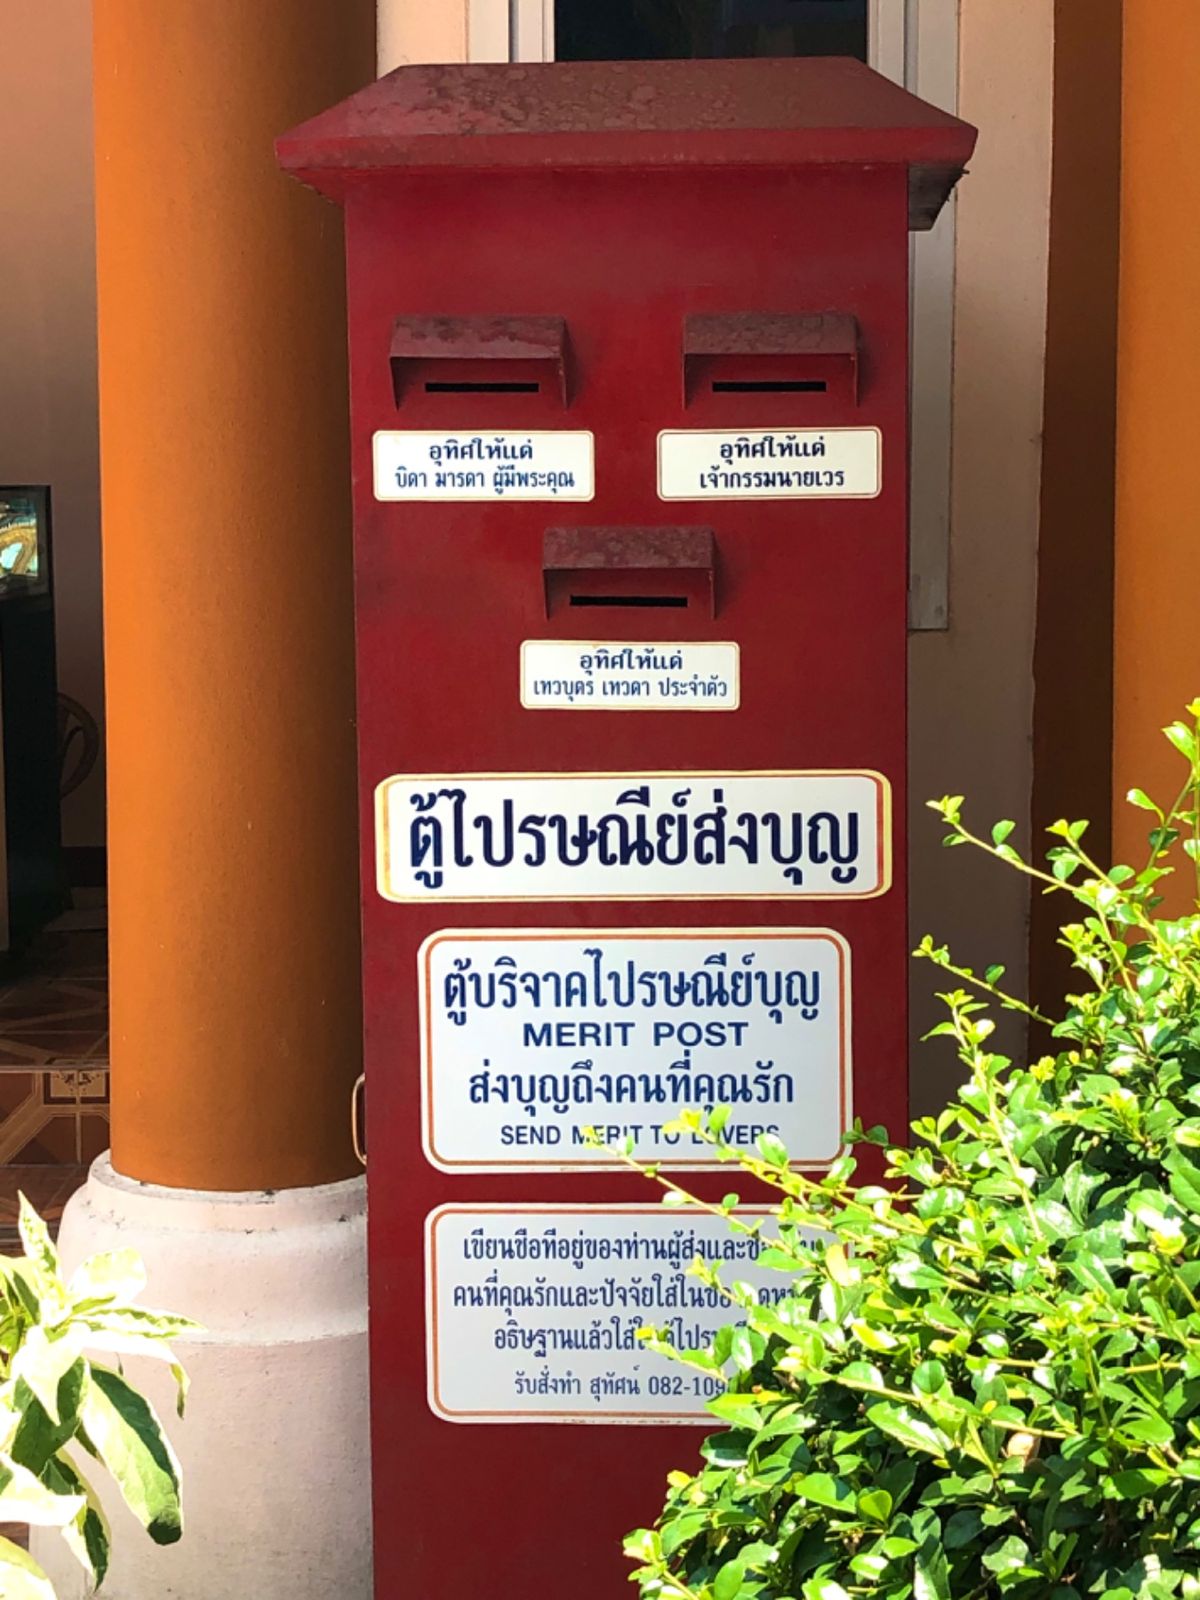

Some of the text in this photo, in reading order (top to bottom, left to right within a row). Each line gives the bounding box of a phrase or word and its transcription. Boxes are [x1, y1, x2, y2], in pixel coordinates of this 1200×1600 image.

[395, 464, 575, 495] บิดา มารดา ผู้มีพระคุณ
[700, 465, 845, 489] เจ้ากรรมนายเวร
[602, 680, 650, 696] เทวดา
[409, 786, 859, 889] ตู้ไปรษณีย์ส่งบุญ
[444, 948, 820, 1026] ตู้บริจาคไปรษณีย์บุญ
[523, 1021, 749, 1047] MERIT POST
[469, 1050, 794, 1117] ส่งบุญถึงคนที่คุณรัก
[501, 1125, 561, 1145] SEND
[514, 1365, 582, 1395] รับสั่งทำ
[590, 1364, 641, 1403] สุทัศน์
